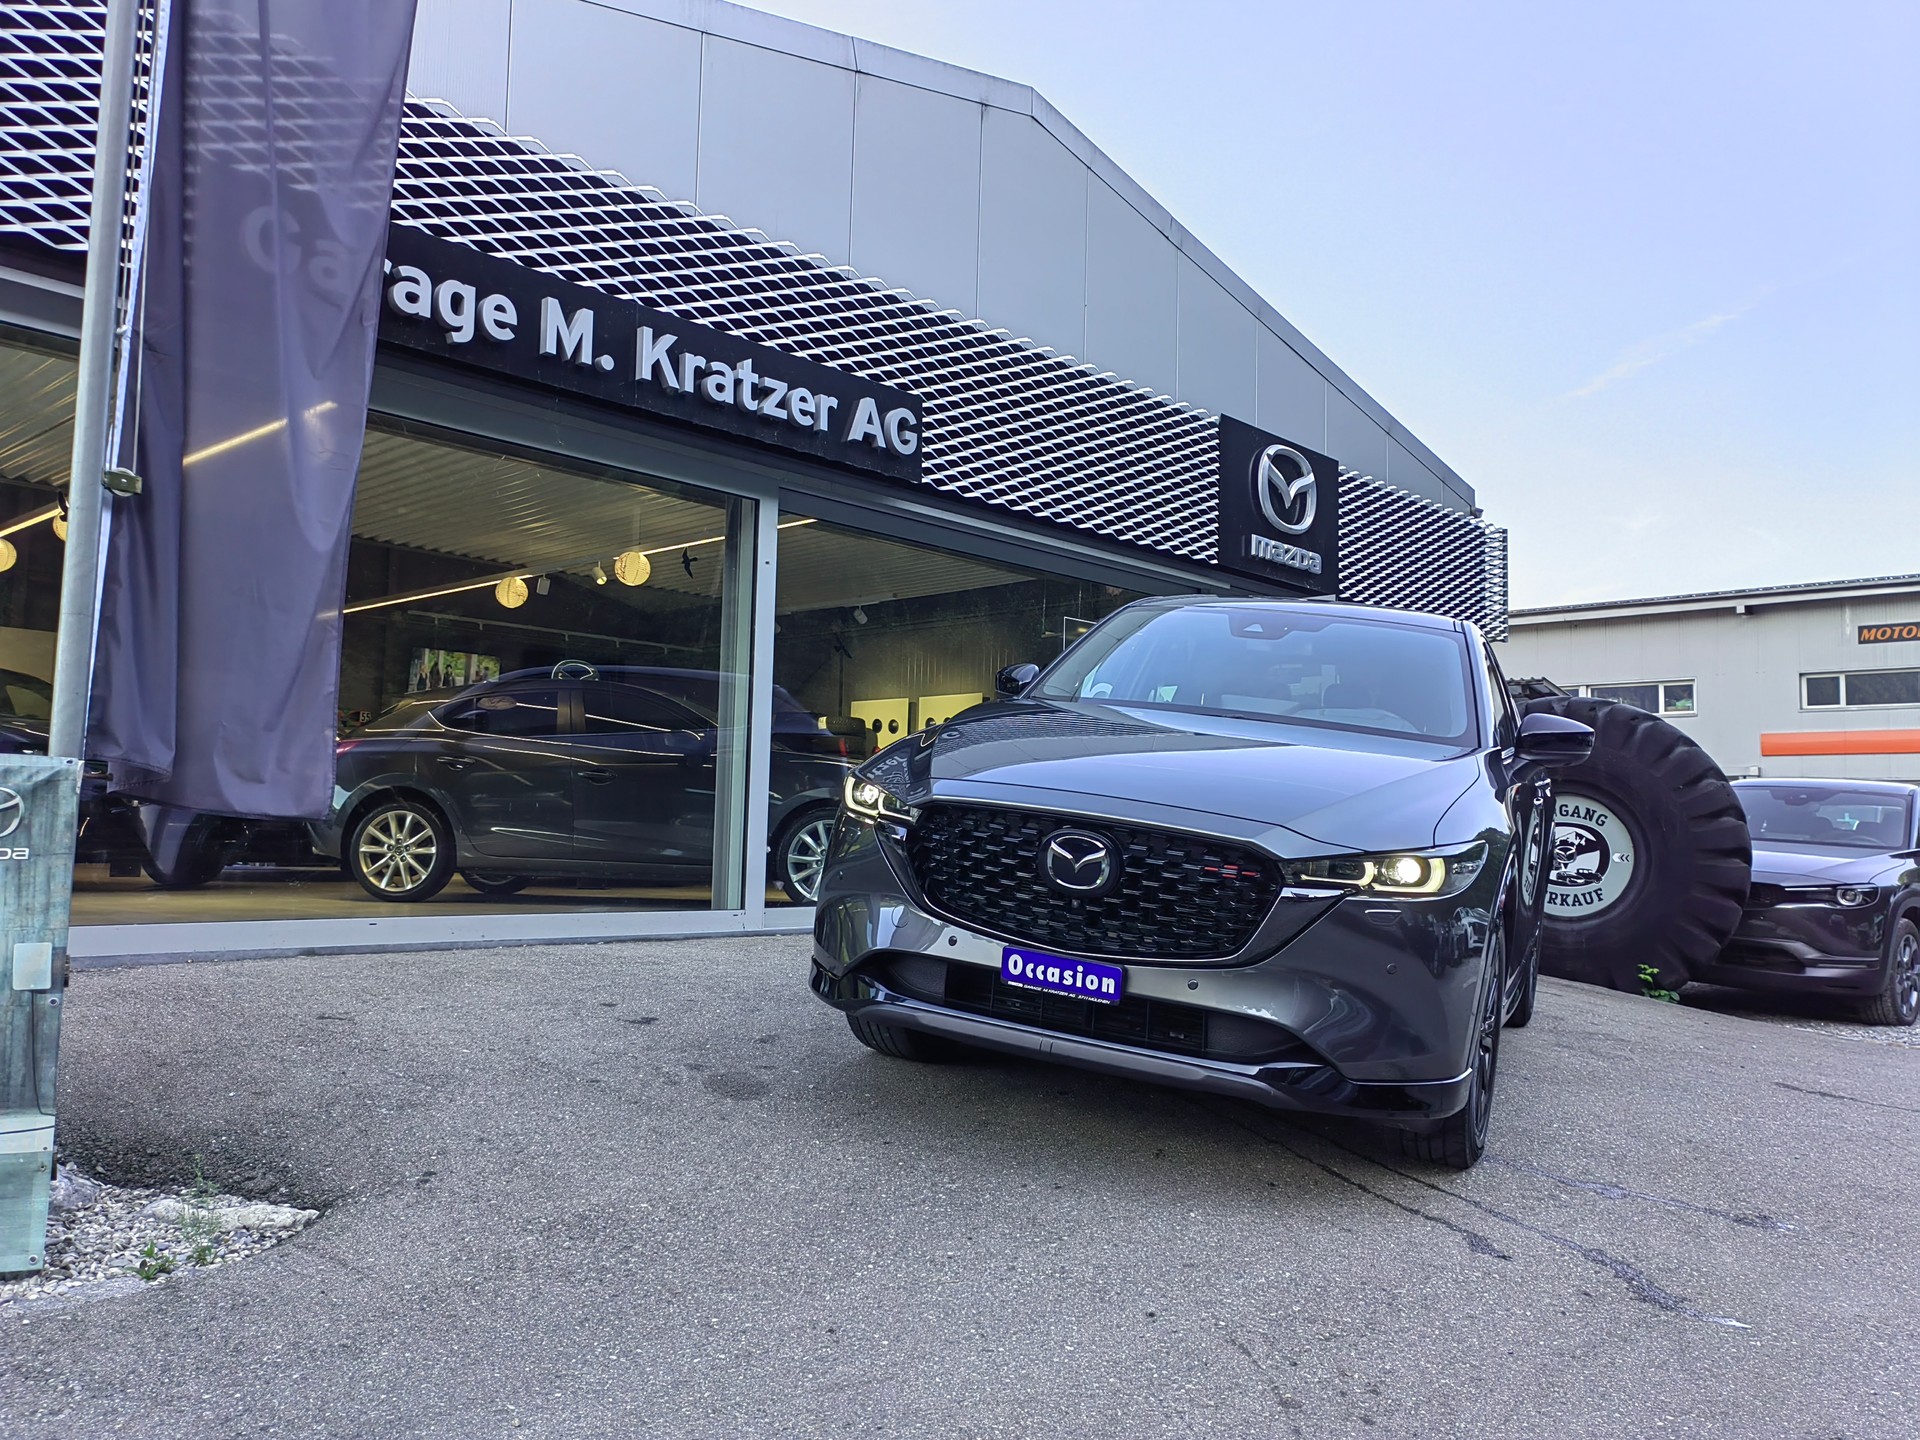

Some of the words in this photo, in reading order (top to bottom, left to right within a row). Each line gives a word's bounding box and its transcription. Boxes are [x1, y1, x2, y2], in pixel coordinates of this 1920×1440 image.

[539, 296, 615, 371] M.
[635, 325, 838, 432] Kratzer
[845, 397, 918, 455] AG
[1250, 533, 1322, 575] mazda
[1555, 804, 1608, 827] GANG
[1546, 888, 1604, 907] RKAUF
[1008, 953, 1115, 994] Occasion
